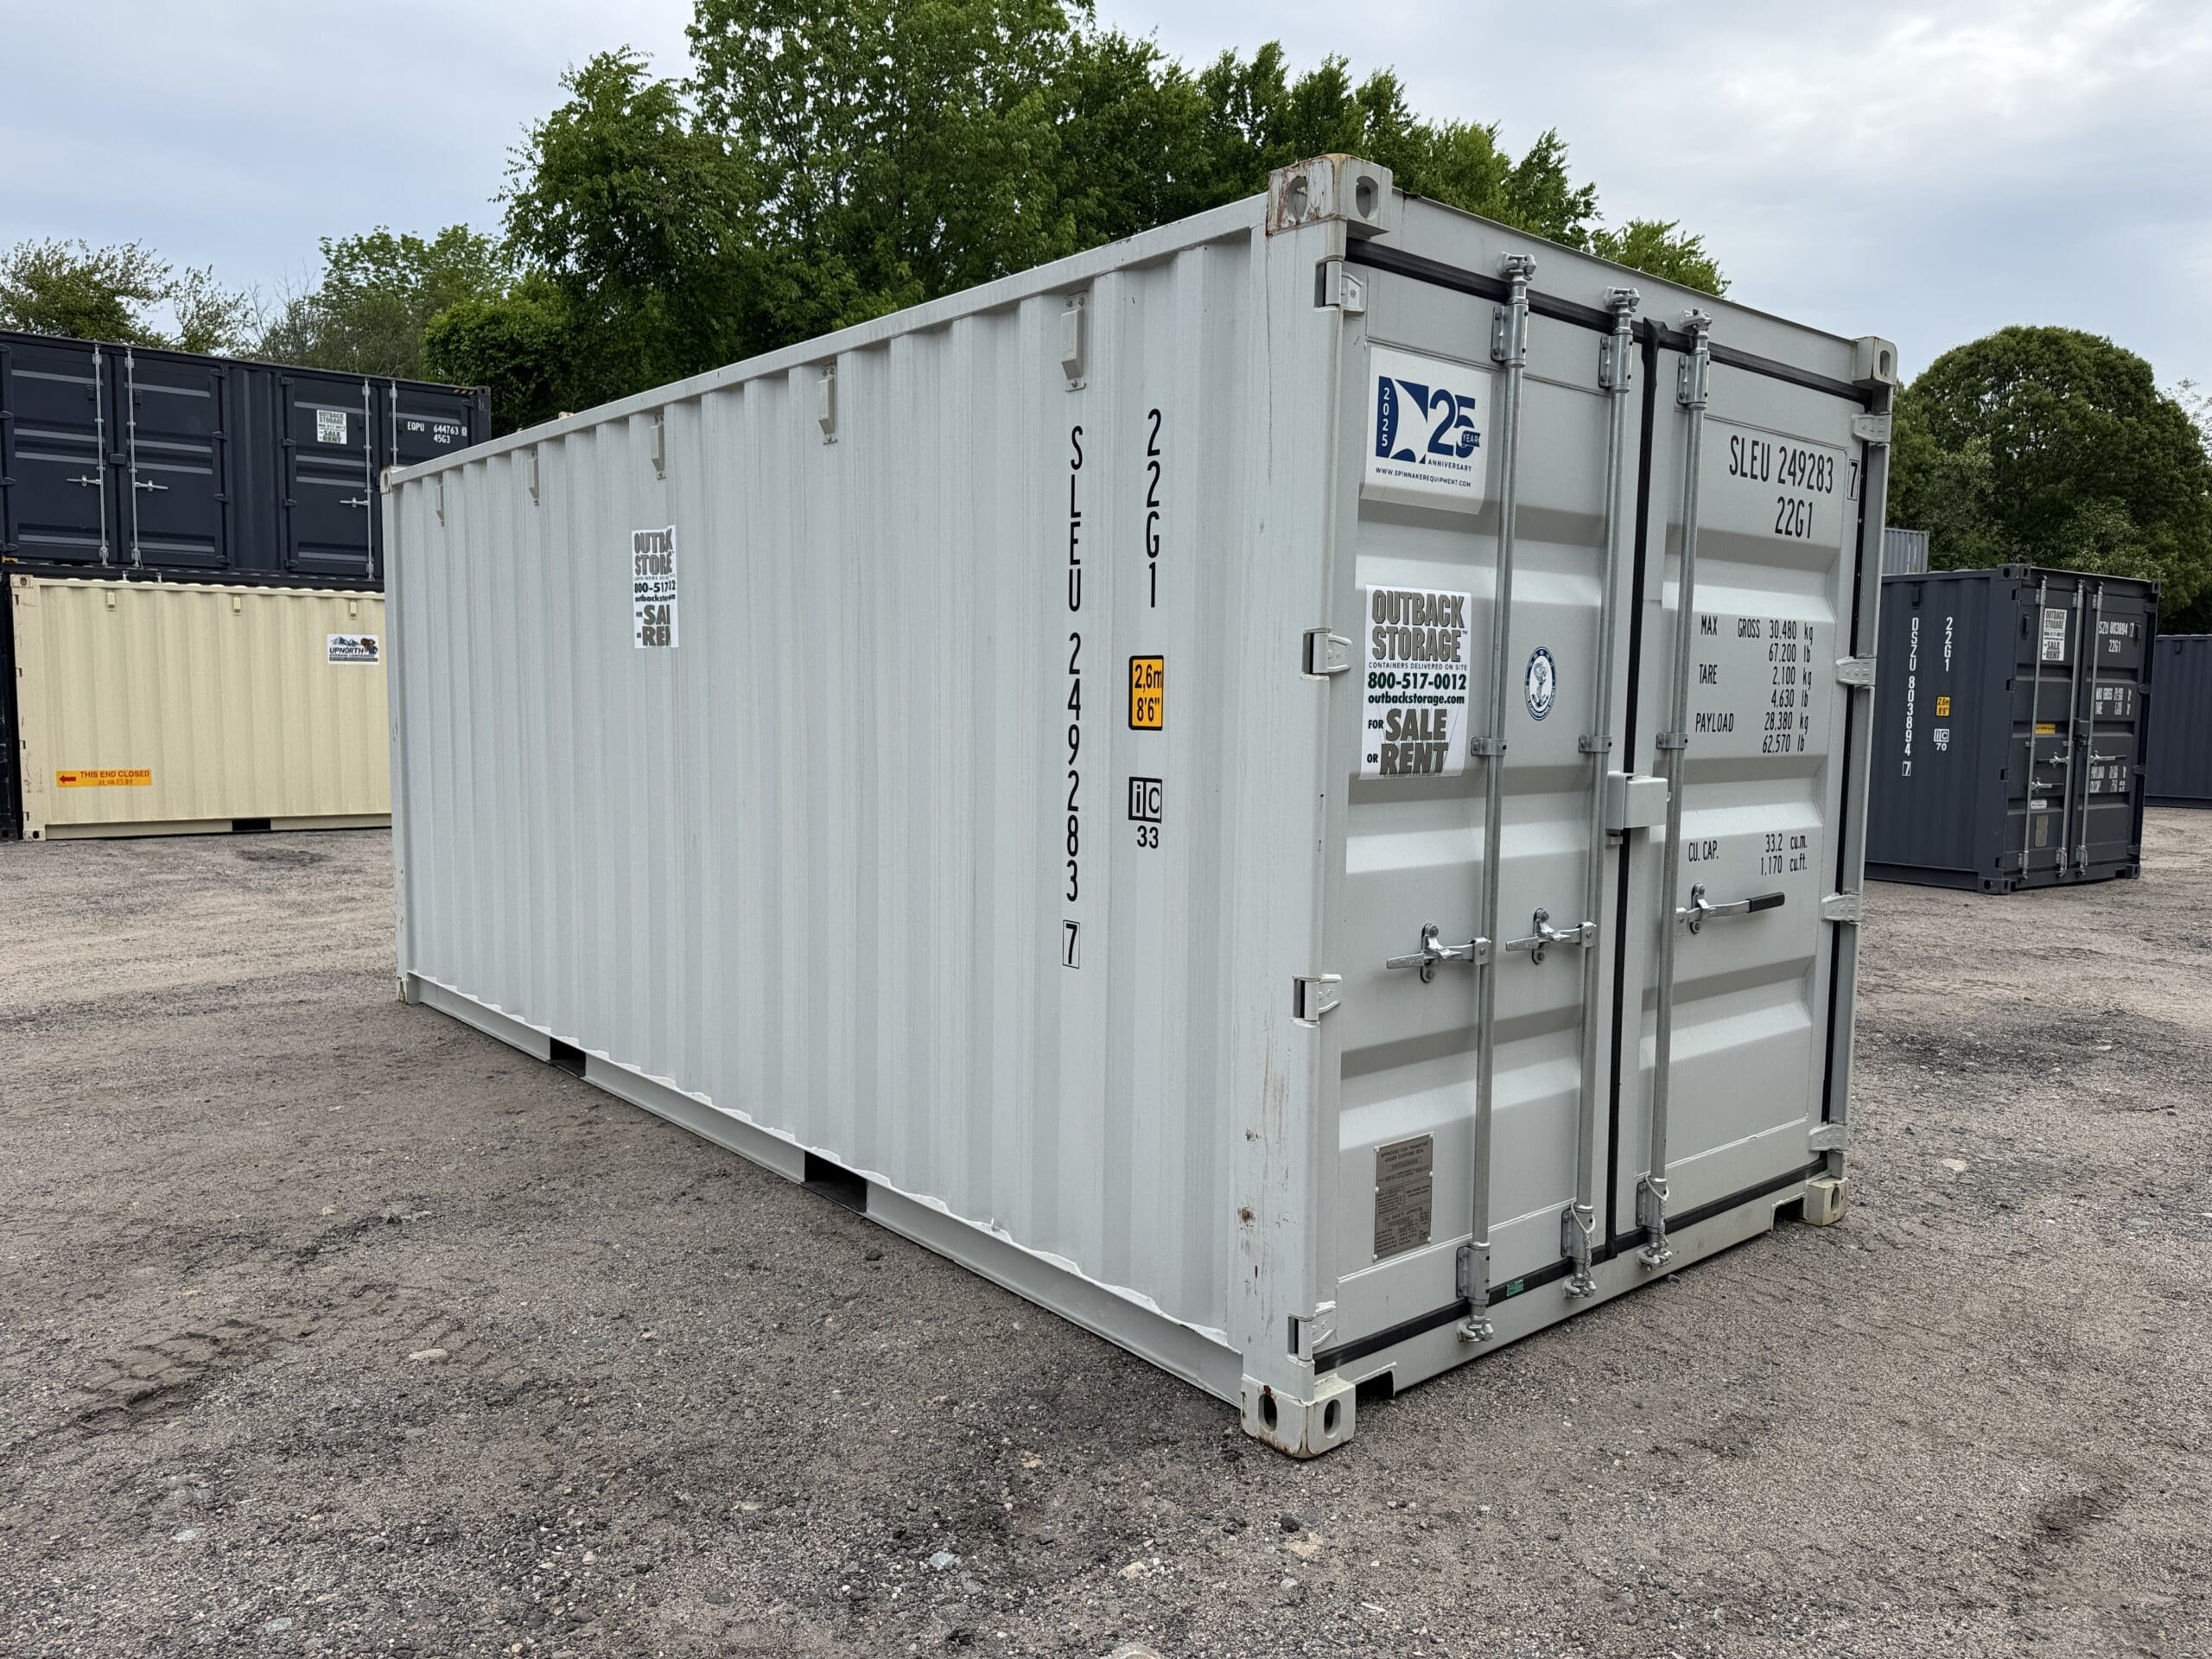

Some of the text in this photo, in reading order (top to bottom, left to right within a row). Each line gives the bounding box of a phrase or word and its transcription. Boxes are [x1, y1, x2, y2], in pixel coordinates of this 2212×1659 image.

[407, 422, 425, 432] EQPU
[434, 424, 459, 435] 644763
[1381, 387, 1389, 447] 2025
[1427, 389, 1476, 459] 25
[434, 434, 451, 444] 45G3
[1463, 433, 1479, 443] YEAR
[1376, 467, 1471, 487] WWW.SPINNAKEREQUIPMENT.COM
[1427, 459, 1471, 472] ANNIVERSARY
[1729, 435, 1858, 498] SLEU 249283 7
[1146, 408, 1161, 608] 22G1
[1775, 496, 1813, 539] 22G1
[1372, 589, 1465, 628] OUTBACK
[1700, 615, 1813, 645] MAX GROSS 30,480 kg
[1372, 626, 1461, 662] STORAGE
[1769, 643, 1811, 663] 67,200 lb
[1910, 617, 1919, 671] DSZU
[1944, 617, 1953, 671] 22G1
[1368, 672, 1467, 690] 800-517-0012
[1699, 664, 1811, 690] TARE 2,100 kg
[1066, 425, 1083, 964] SLEU 249283 7
[1368, 691, 1465, 706] outbackstorage.com
[1771, 690, 1808, 709] 4,630 lb
[1137, 696, 1160, 722] 8'6"
[1904, 676, 1915, 756] 803894
[1368, 709, 1447, 741] FOR SALE
[1695, 712, 1808, 734] PAYLOAD 28,380 kg
[1763, 734, 1804, 753] 62,570 lb
[1367, 741, 1449, 776] OR RENT
[1137, 825, 1159, 849] 33
[1688, 833, 1808, 861] CU. CAP. 33.2 cu.m.
[1761, 854, 1808, 876] 1,170 cu.ft.
